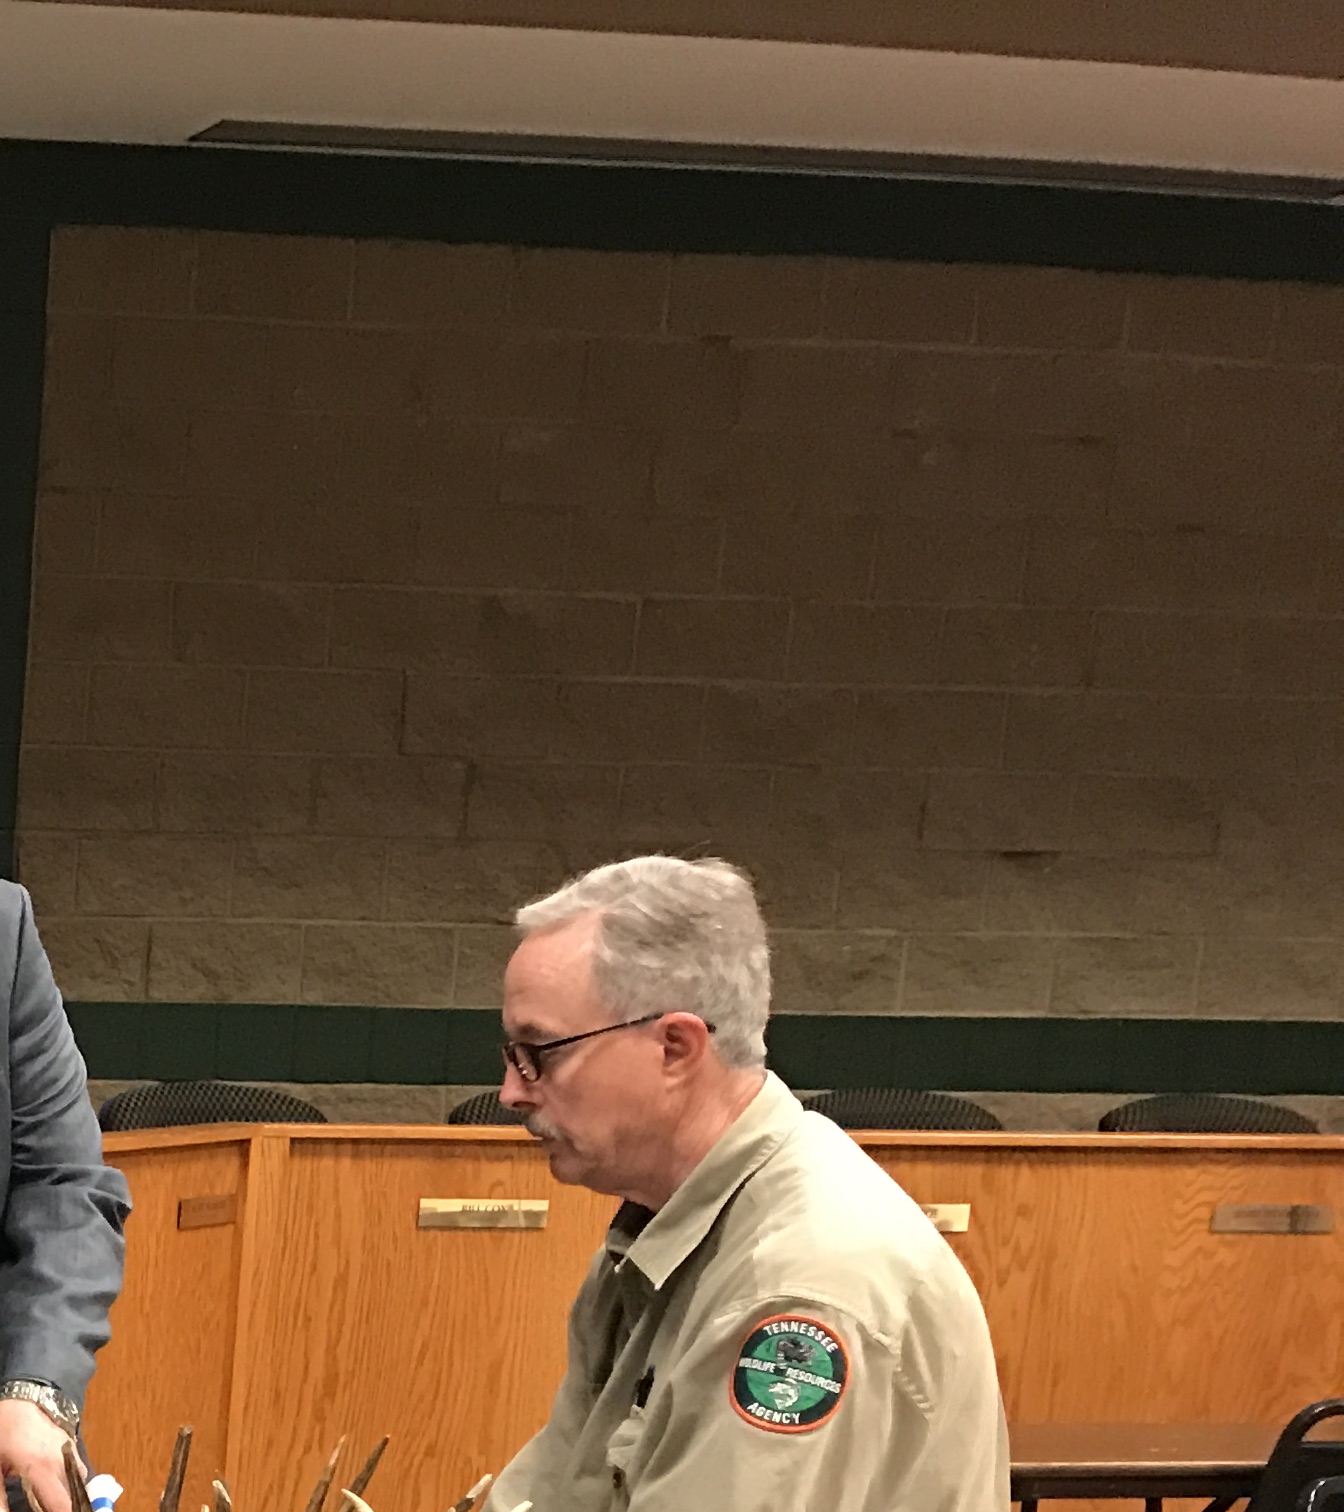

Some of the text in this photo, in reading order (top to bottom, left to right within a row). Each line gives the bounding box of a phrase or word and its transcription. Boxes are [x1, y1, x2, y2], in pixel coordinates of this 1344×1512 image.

[762, 1320, 839, 1353] TENNESSEE
[738, 1357, 843, 1394] WILDLIFE RESOURCES
[746, 1402, 801, 1424] AGENCY
